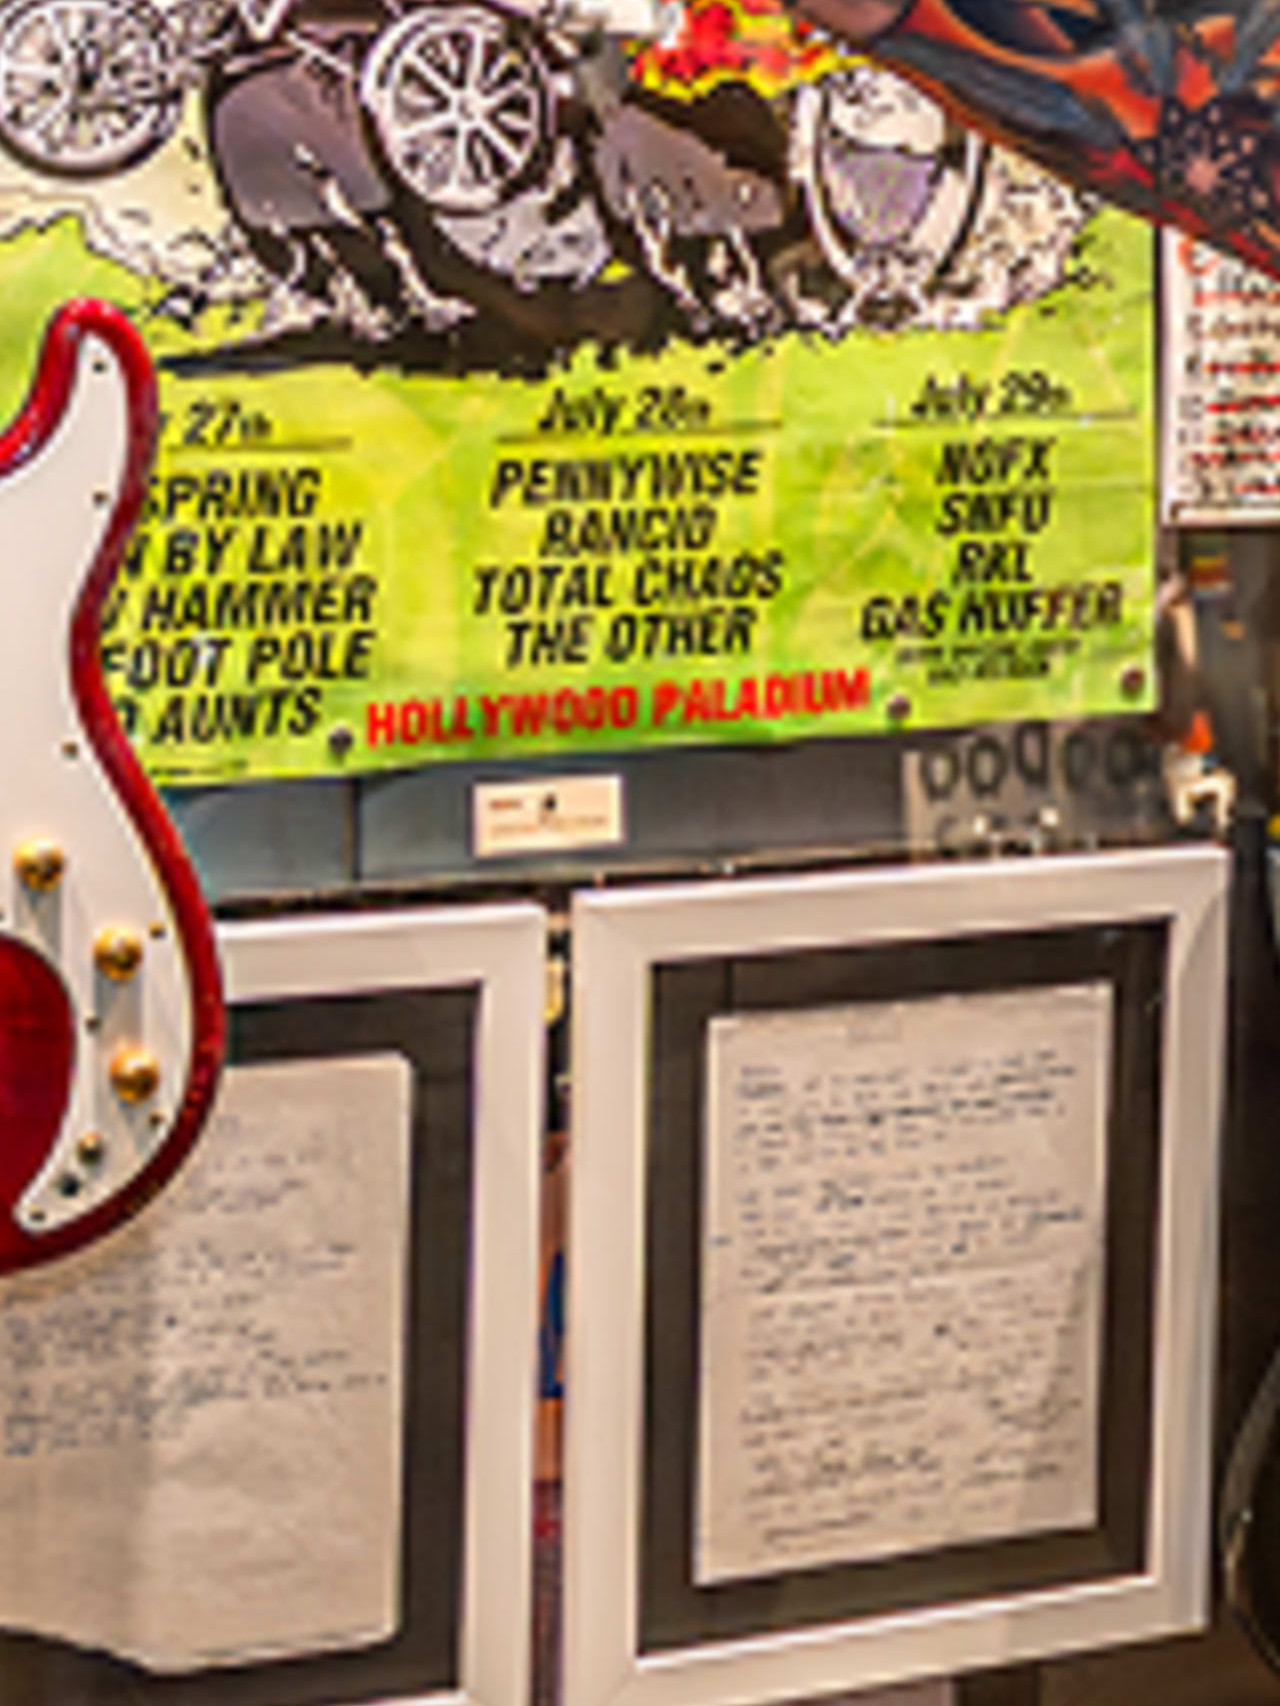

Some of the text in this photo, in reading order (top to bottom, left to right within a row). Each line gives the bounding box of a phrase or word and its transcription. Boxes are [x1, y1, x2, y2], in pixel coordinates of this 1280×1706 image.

[537, 386, 625, 438] July
[911, 371, 992, 420] July
[489, 449, 764, 510] PENNYWISE
[935, 437, 1057, 487] NOFX
[164, 526, 235, 577] BY
[246, 521, 364, 575] LAW
[538, 502, 719, 559] RANCID
[140, 574, 379, 635] HAMMER
[473, 547, 787, 616] TOTAL CHAOS
[505, 606, 759, 668] THE OTHER
[860, 580, 1124, 643] GAS HUFFER
[247, 630, 378, 686] POLE
[150, 687, 324, 746] AUNTS
[366, 685, 641, 749] HOLLYWOOD
[651, 667, 871, 727] PALADIUM
